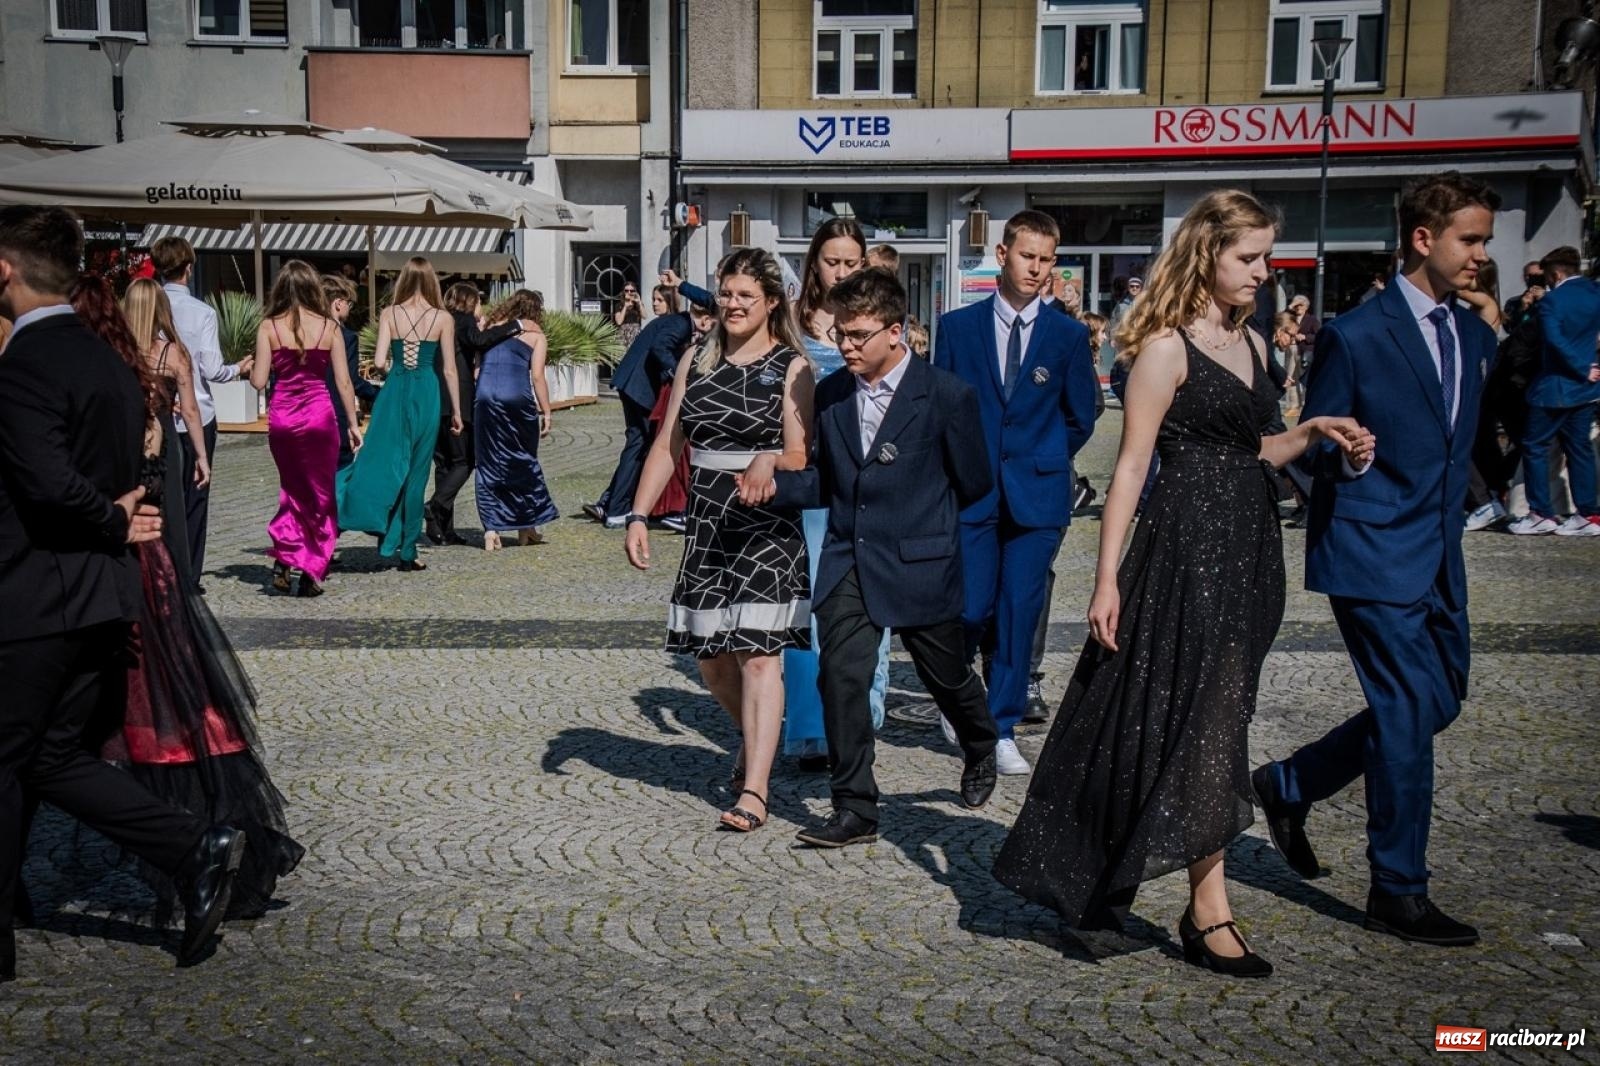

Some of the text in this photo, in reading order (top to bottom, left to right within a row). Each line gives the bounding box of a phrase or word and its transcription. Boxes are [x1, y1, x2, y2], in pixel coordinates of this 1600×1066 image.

[840, 116, 891, 136] TEB
[1154, 102, 1416, 144] ROSSMANN
[839, 139, 891, 148] EDUKACJA
[145, 182, 242, 205] gelatopiu
